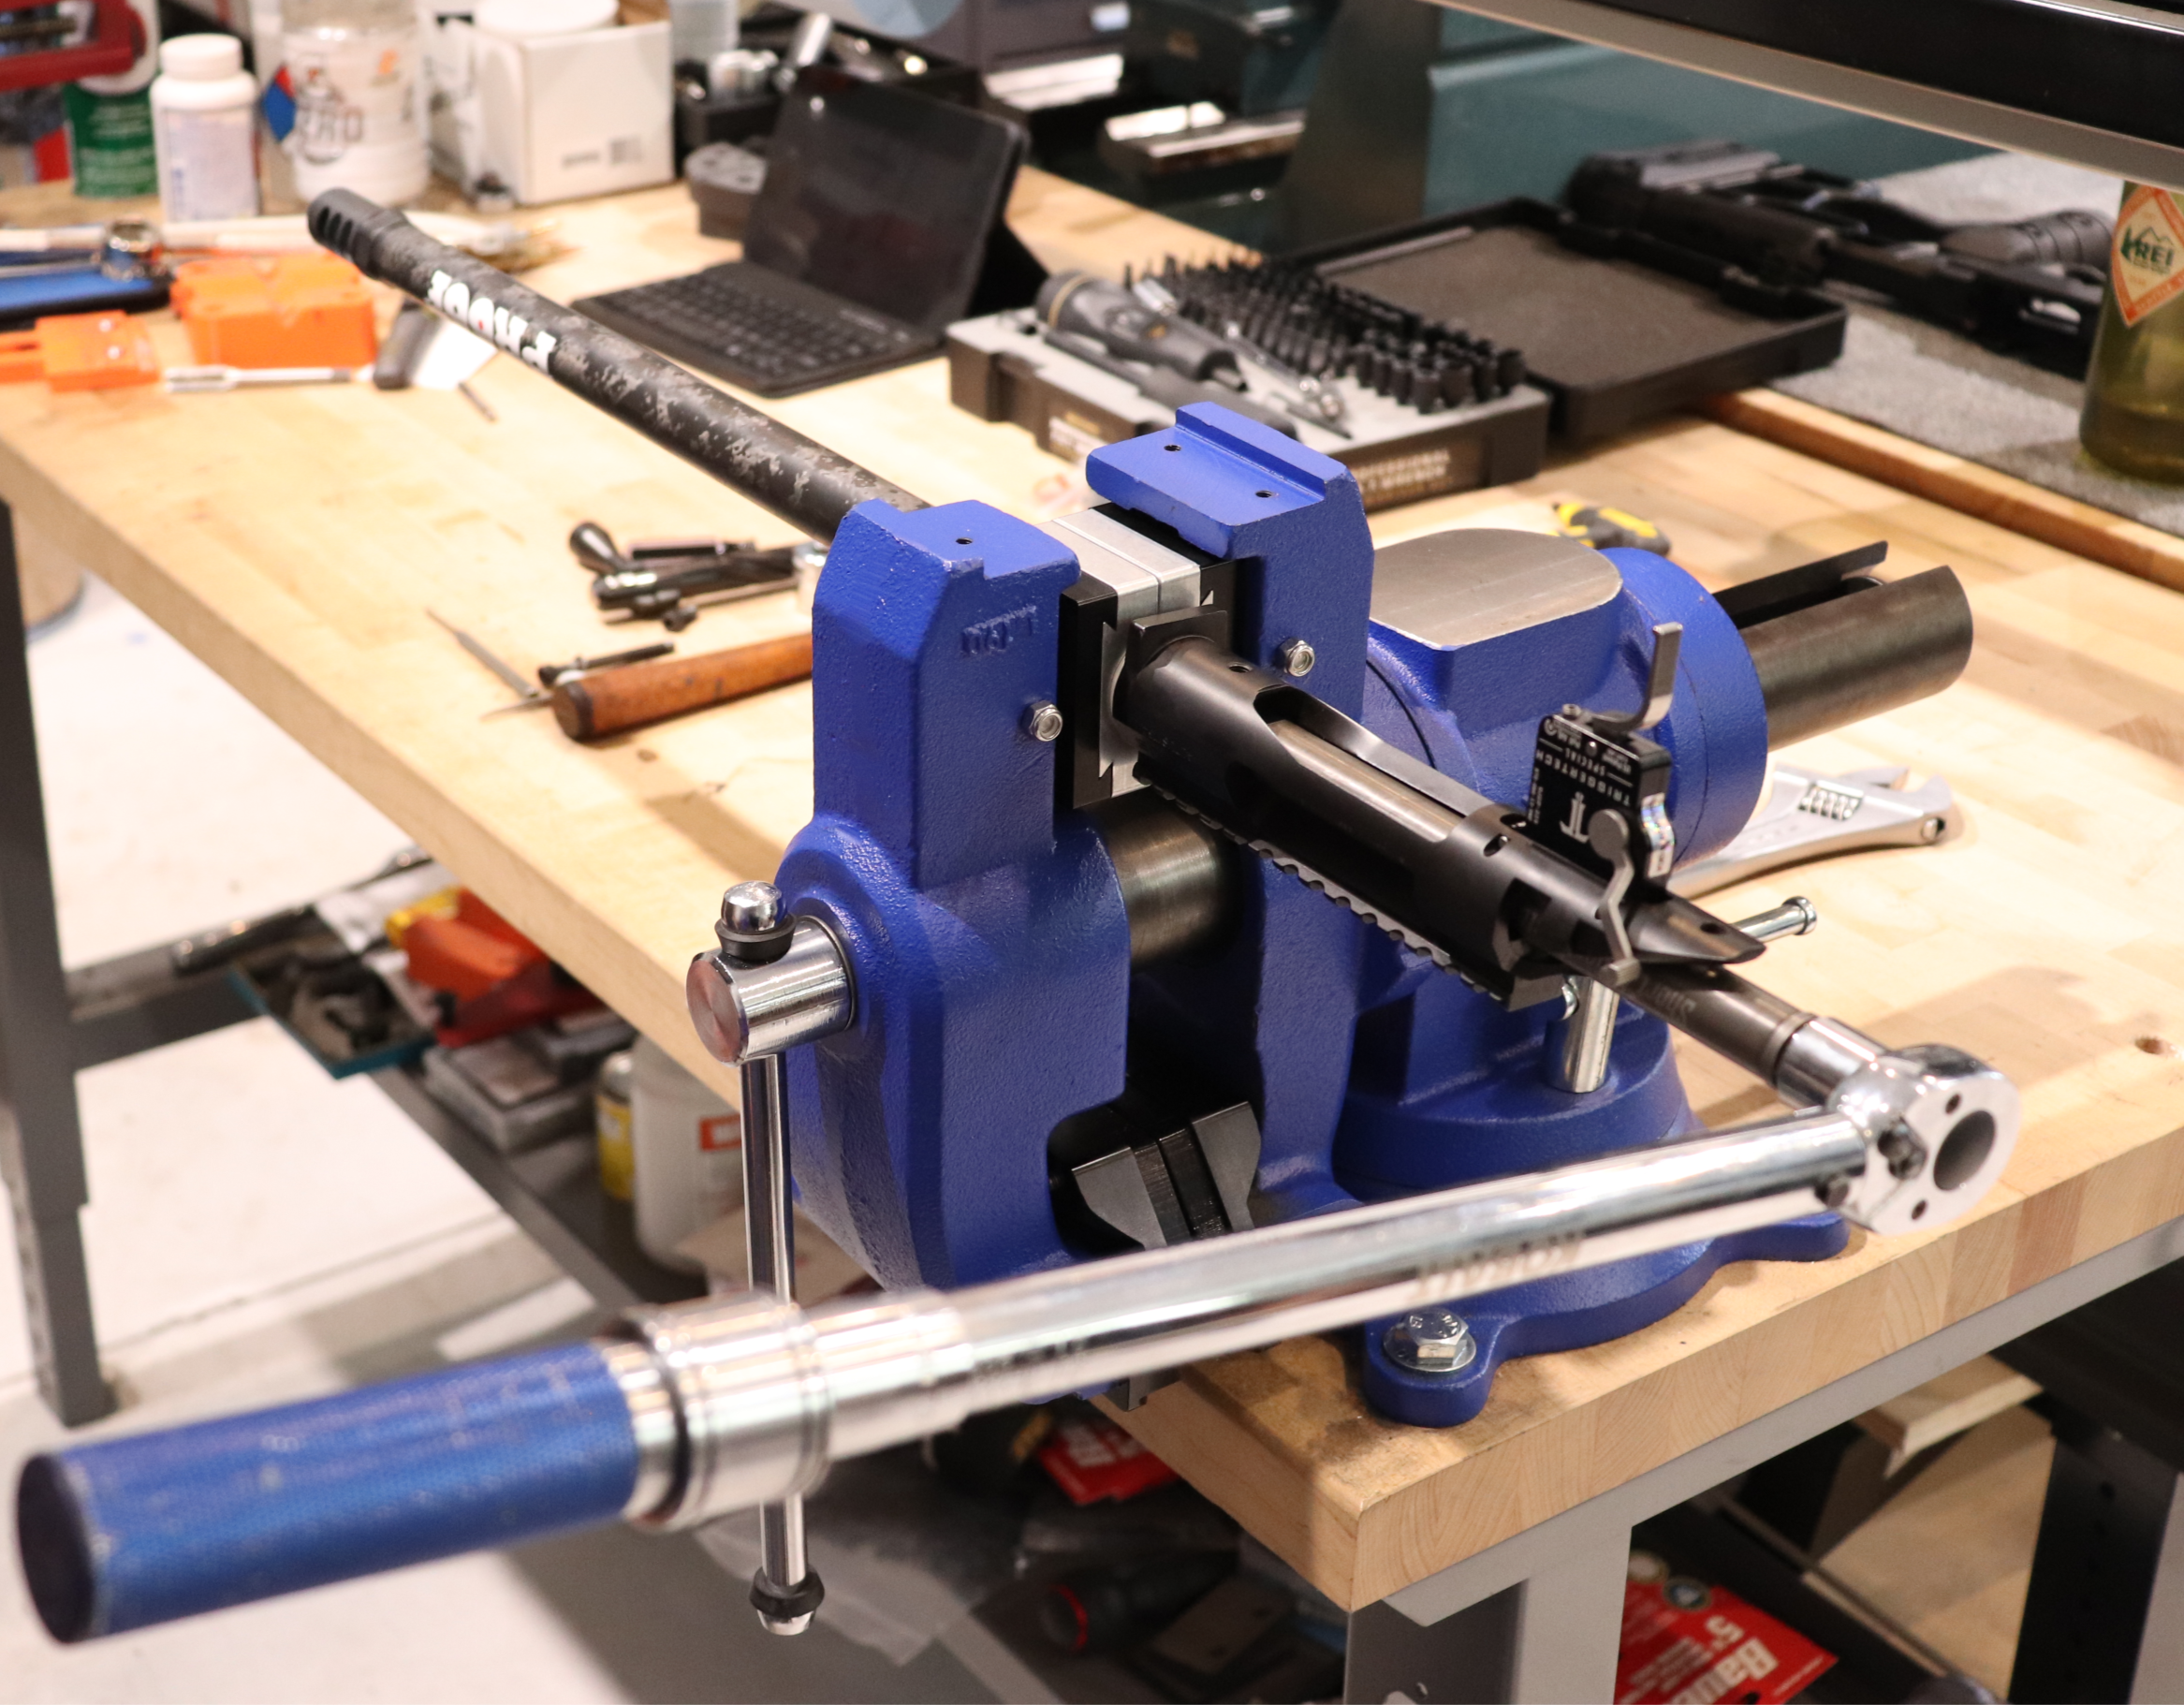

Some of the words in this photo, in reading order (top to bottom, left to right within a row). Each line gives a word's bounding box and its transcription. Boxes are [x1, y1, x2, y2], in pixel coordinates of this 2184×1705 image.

[2134, 238, 2174, 267] REI
[1564, 747, 1606, 777] SPECIAL
[1535, 749, 1630, 807] TRIGGERTECH
